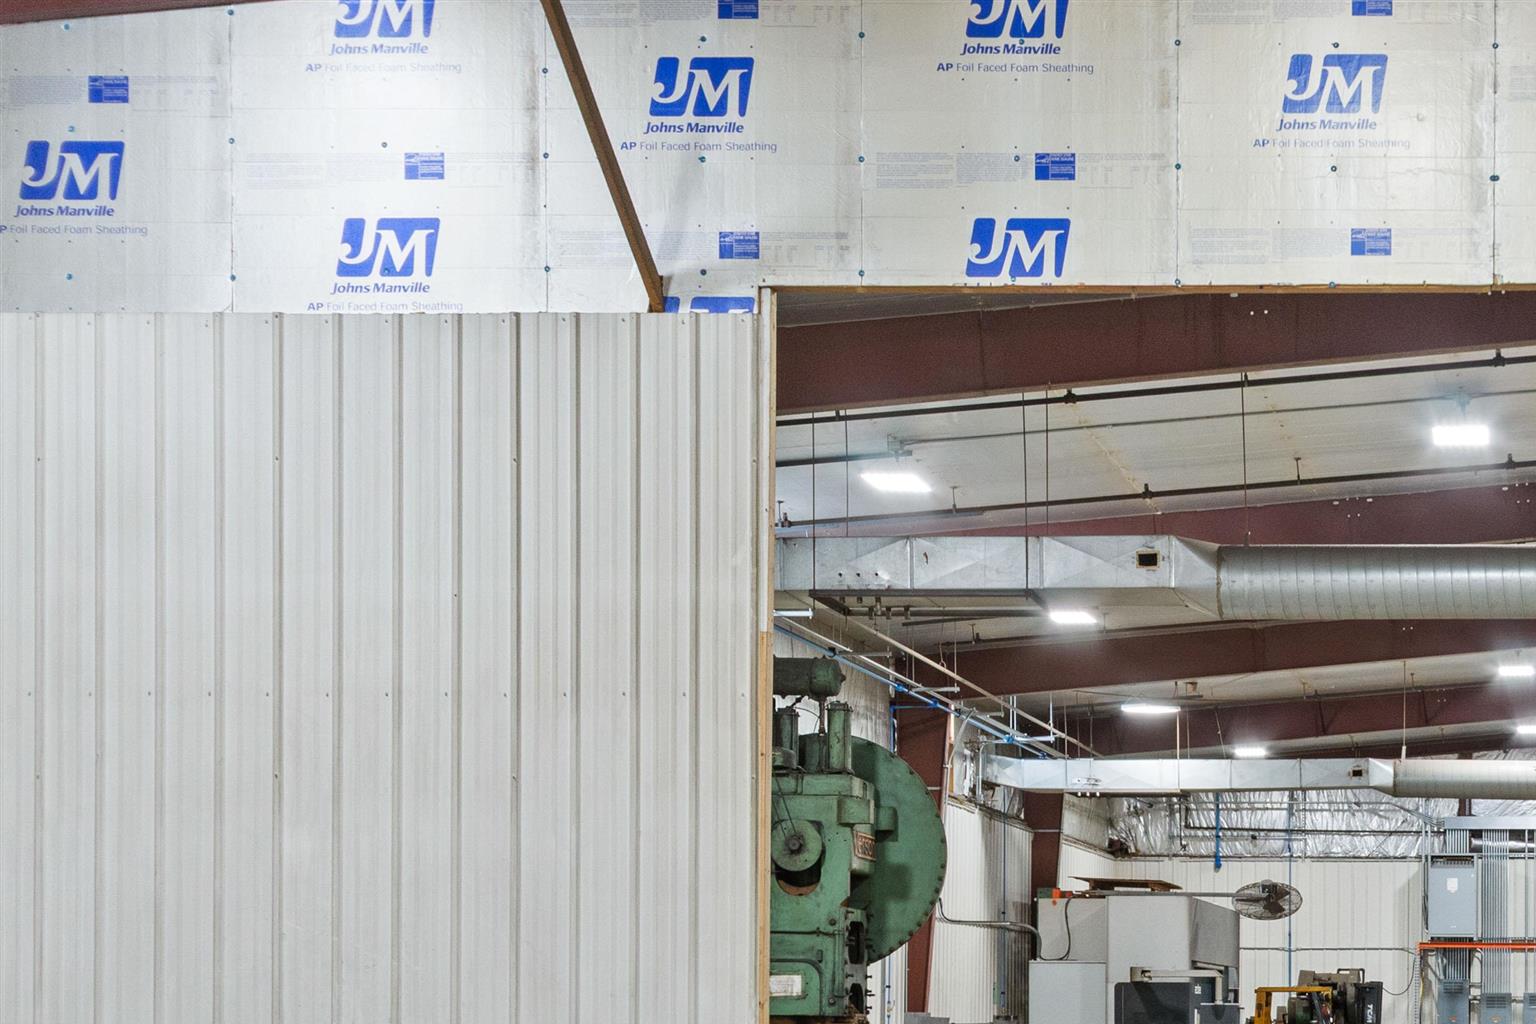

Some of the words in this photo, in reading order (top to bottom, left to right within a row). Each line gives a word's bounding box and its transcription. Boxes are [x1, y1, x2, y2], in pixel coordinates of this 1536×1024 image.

[328, 43, 368, 55] Johns
[371, 43, 428, 54] Manville
[960, 43, 1000, 56] Johns
[1003, 44, 1060, 55] Manville
[936, 63, 953, 72] AP
[956, 63, 974, 72] Foil
[978, 63, 1007, 72] Faced
[1010, 63, 1039, 72] Foam
[1042, 63, 1094, 75] Sheathing
[650, 57, 754, 117] JM
[1282, 54, 1388, 114] JM
[644, 122, 684, 134] Johns
[686, 122, 744, 133] Manville
[1276, 119, 1316, 131] Johns
[1319, 119, 1376, 130] Manville
[620, 142, 637, 151] AP
[640, 142, 658, 151] Foil
[661, 142, 691, 151] Faced
[694, 142, 722, 151] Foam
[725, 142, 778, 153] Sheathing
[1253, 139, 1270, 148] AP
[1272, 139, 1290, 148] Foil
[1294, 139, 1323, 148] Faced
[1326, 138, 1355, 148] Foam
[1357, 138, 1409, 149] Sheathing
[20, 140, 125, 200] JM
[14, 204, 54, 218] Johns
[56, 205, 114, 216] Manville
[0, 225, 8, 234] P
[10, 224, 28, 234] Foil
[31, 224, 60, 234] Faced
[64, 224, 92, 234] Foam
[96, 224, 148, 236] Sheathing
[336, 218, 440, 278] JM
[966, 218, 1071, 278] JM
[330, 282, 370, 294] Johns
[372, 282, 430, 293] Manville
[307, 302, 324, 311] AP
[326, 302, 344, 311] Foil
[348, 302, 377, 311] Faced
[380, 302, 408, 311] Foam
[412, 301, 464, 312] Sheathing
